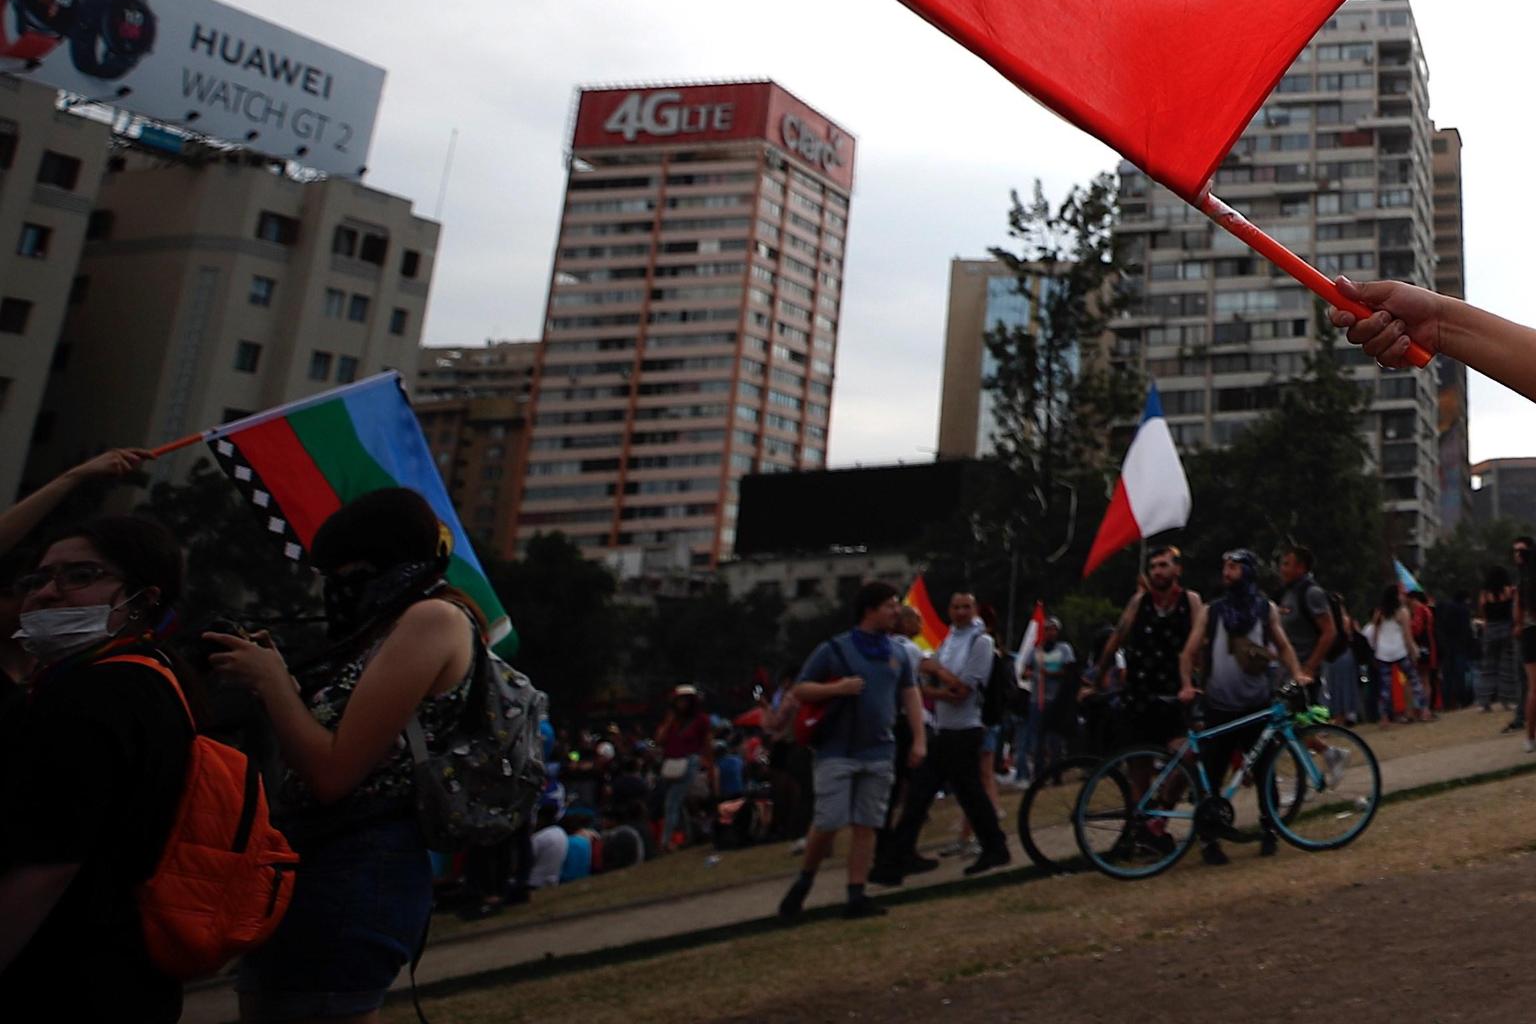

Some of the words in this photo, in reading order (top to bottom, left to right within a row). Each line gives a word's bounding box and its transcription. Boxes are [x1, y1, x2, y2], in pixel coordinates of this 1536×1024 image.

[190, 23, 334, 102] HUAWEI
[181, 68, 288, 129] WATCH
[291, 107, 330, 144] GT
[334, 122, 354, 154] 2
